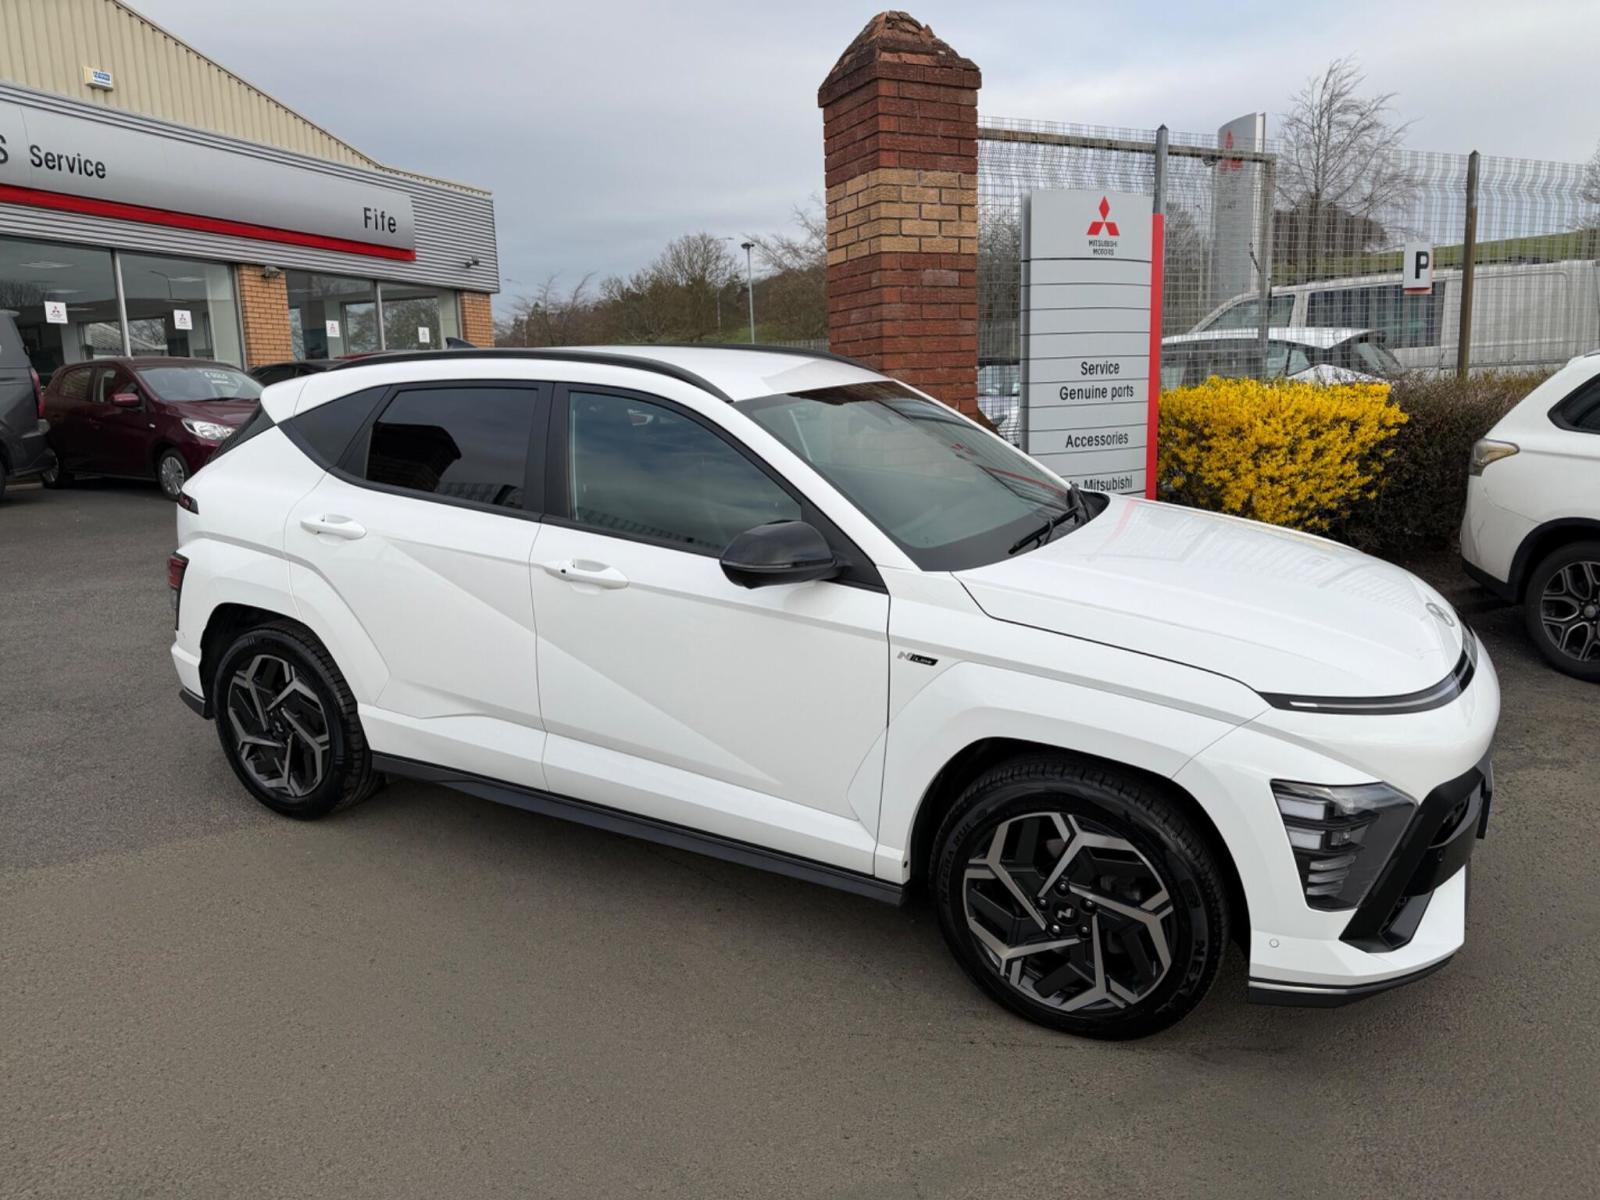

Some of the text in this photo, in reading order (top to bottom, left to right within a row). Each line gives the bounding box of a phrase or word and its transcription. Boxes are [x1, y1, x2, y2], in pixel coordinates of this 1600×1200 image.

[29, 144, 106, 179] Service
[363, 206, 397, 233] Fife
[1414, 250, 1430, 279] P
[1080, 360, 1120, 376] Service
[1059, 384, 1135, 401] Genuine parts
[1065, 432, 1129, 449] Accessories
[1083, 475, 1133, 492] Mitsubishi
